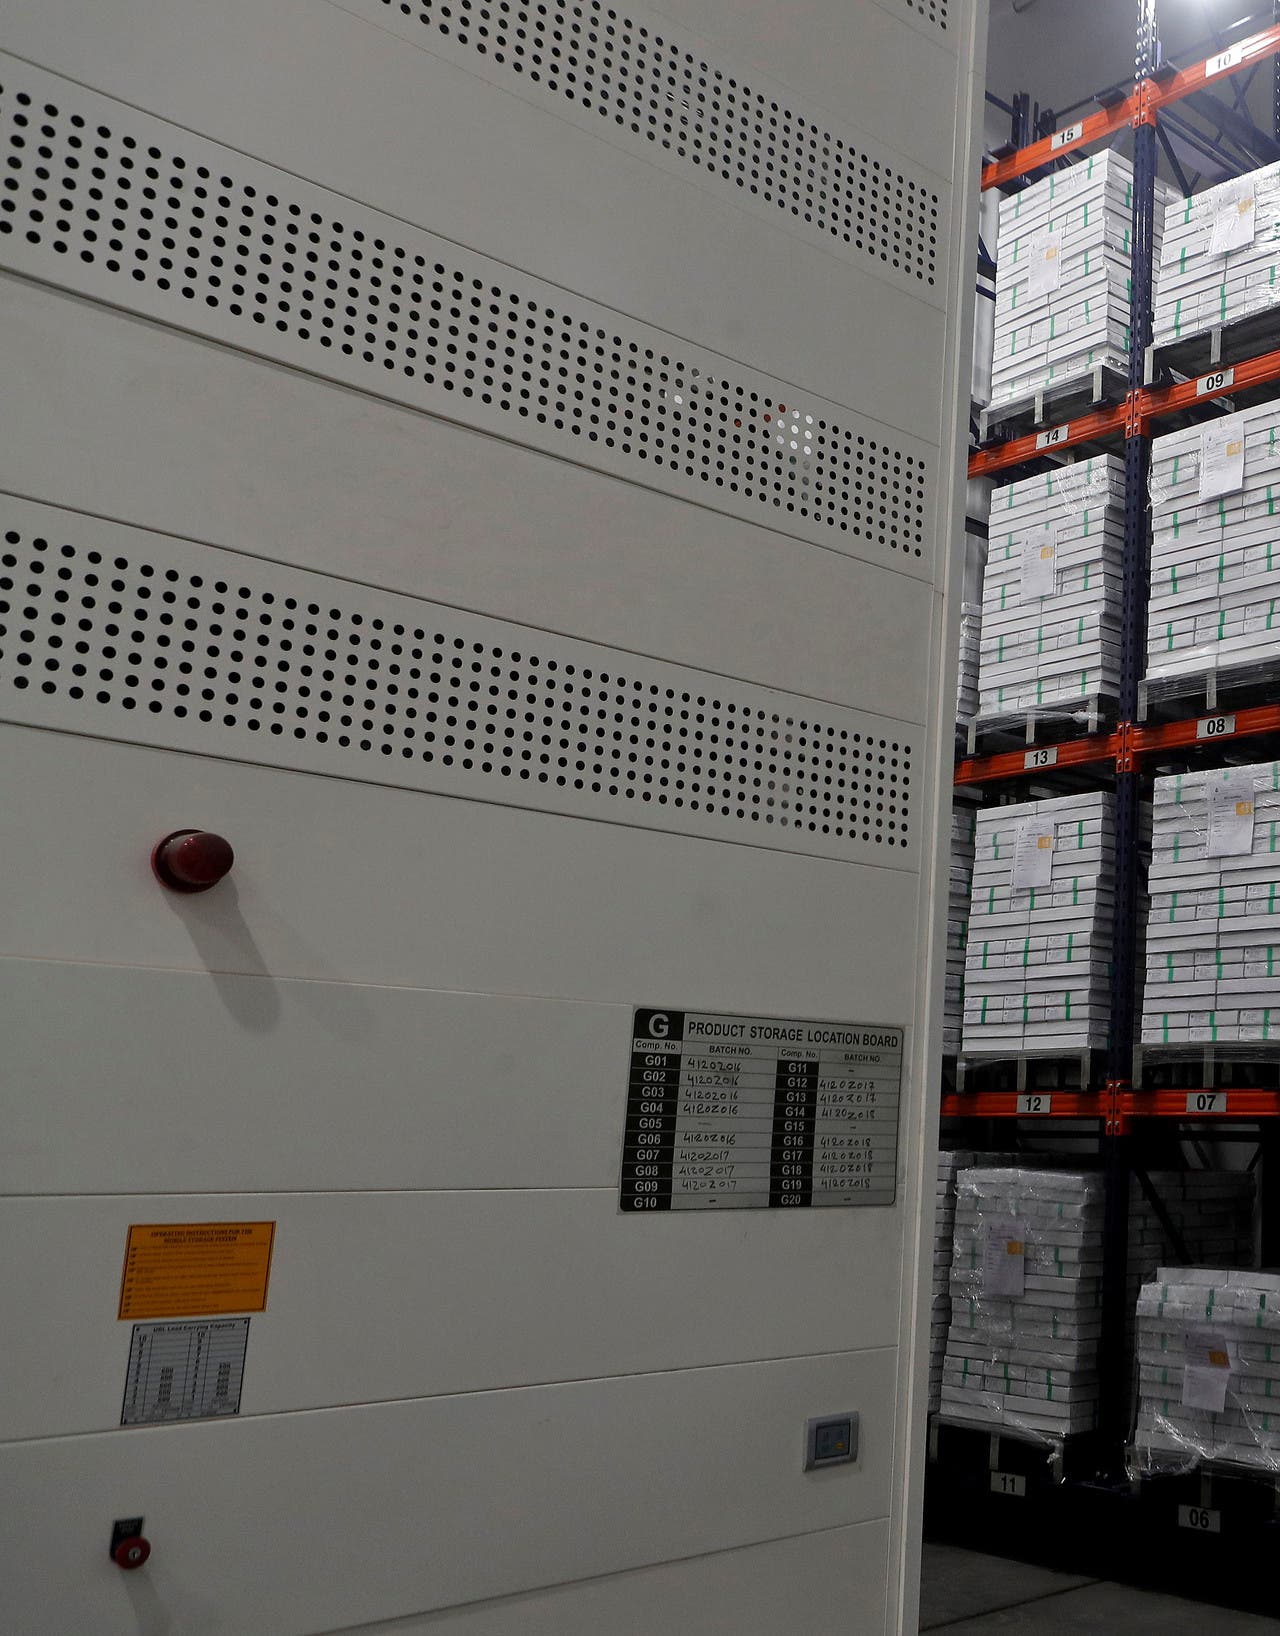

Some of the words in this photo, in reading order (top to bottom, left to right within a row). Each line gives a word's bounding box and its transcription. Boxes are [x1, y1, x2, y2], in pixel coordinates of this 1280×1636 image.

[1060, 130, 1074, 144] 15
[1206, 374, 1224, 391] 09
[1045, 429, 1059, 445] 14
[1207, 718, 1225, 735] 08
[1033, 750, 1048, 766] 13
[648, 1013, 669, 1038] G
[688, 1021, 746, 1038] PRODUCT
[750, 1025, 803, 1042] STORAGE
[807, 1030, 860, 1046] LOCATION
[862, 1034, 898, 1048] BOARD
[635, 1040, 662, 1051] Comp.
[664, 1042, 678, 1051] No.
[709, 1045, 736, 1055] BATCH
[738, 1047, 753, 1056] NO.
[781, 1048, 804, 1059] Comp.
[806, 1050, 818, 1059] No.
[844, 1054, 868, 1063] BATCH
[645, 1055, 667, 1067] G01
[788, 1063, 807, 1074] G11
[643, 1070, 666, 1083] G02
[787, 1077, 808, 1088] G12
[641, 1086, 665, 1098] G03
[786, 1092, 806, 1103] G13
[640, 1102, 663, 1114] G04
[1025, 1097, 1042, 1112] 12
[1196, 1094, 1216, 1111] 07
[785, 1106, 805, 1117] G14
[639, 1118, 662, 1129] G05
[784, 1121, 805, 1132] G15
[637, 1133, 661, 1145] G06
[783, 1136, 804, 1146] G16
[636, 1149, 660, 1161] G07
[782, 1150, 803, 1161] G17
[635, 1165, 659, 1177] G08
[782, 1165, 802, 1175] G18
[634, 1181, 658, 1192] G09
[781, 1180, 802, 1190] G19
[633, 1197, 657, 1208] G10
[780, 1194, 801, 1205] G20
[1000, 1476, 1016, 1492] 11
[1188, 1509, 1210, 1528] 06
